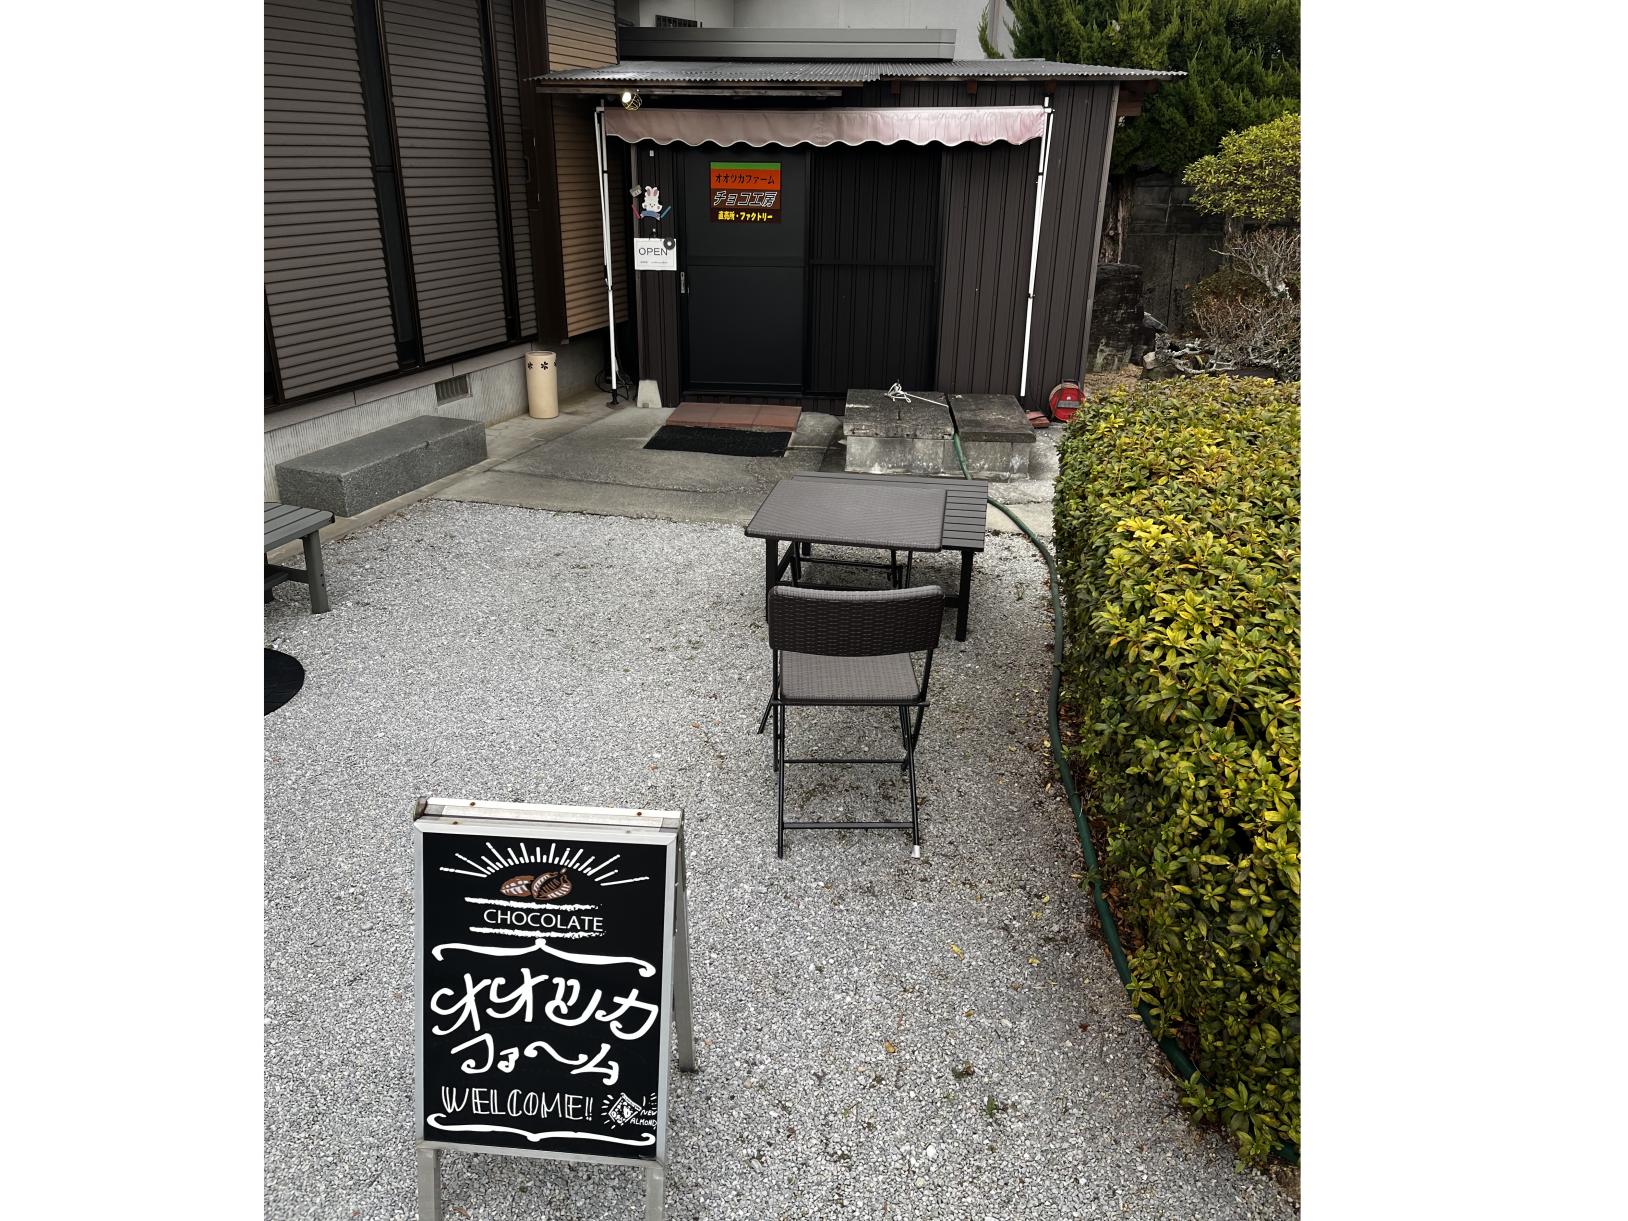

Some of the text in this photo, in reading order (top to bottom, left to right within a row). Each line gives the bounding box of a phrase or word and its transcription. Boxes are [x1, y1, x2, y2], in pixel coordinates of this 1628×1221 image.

[715, 173, 775, 185] オオツカファーム
[713, 190, 778, 207] チョコ工房
[638, 247, 668, 256] OPEN
[483, 909, 604, 932] CHOCOLATE
[430, 968, 659, 1040] オオツカ
[441, 1086, 594, 1121] WELCOME!!
